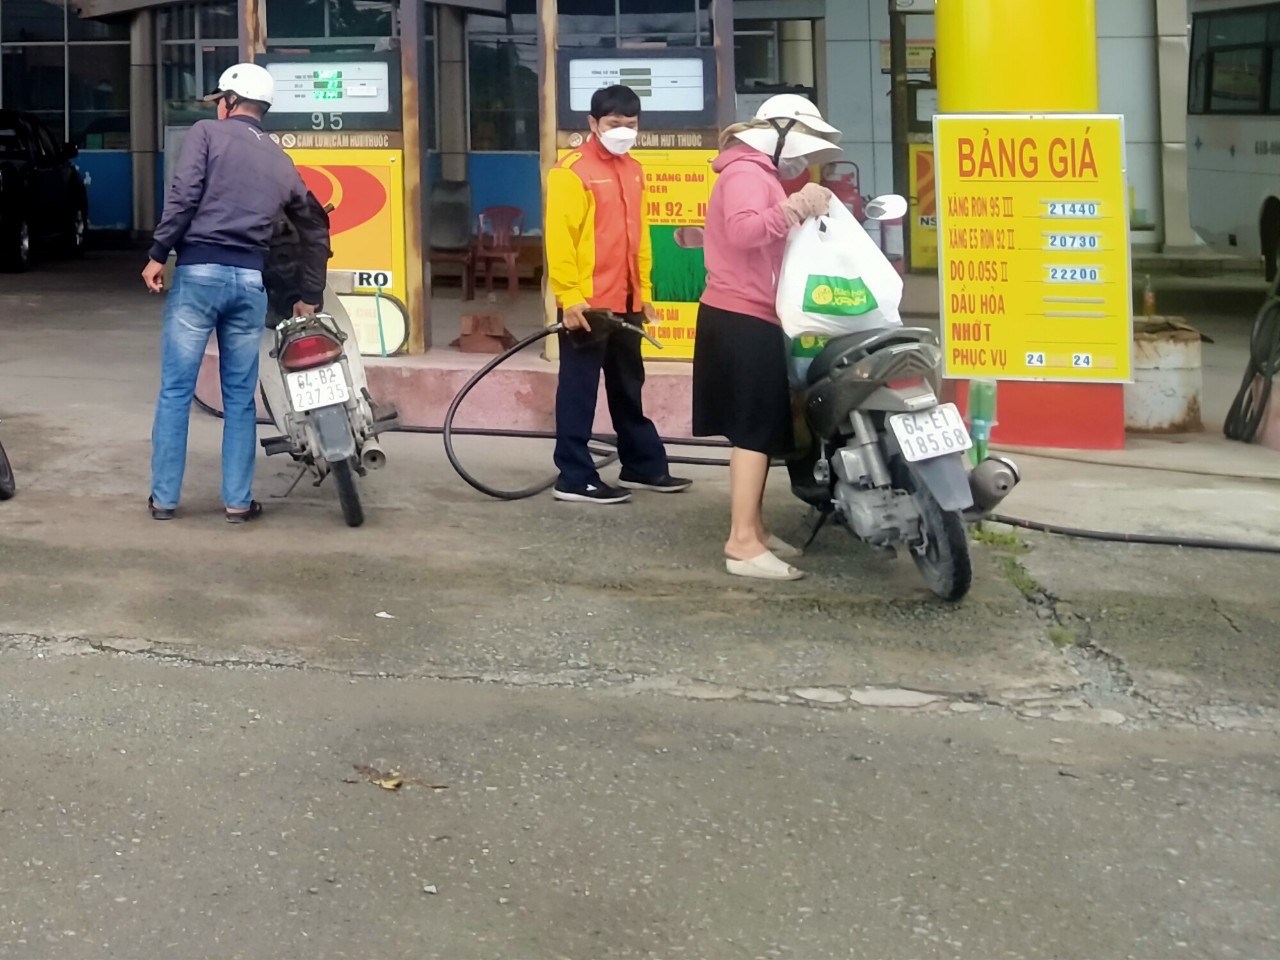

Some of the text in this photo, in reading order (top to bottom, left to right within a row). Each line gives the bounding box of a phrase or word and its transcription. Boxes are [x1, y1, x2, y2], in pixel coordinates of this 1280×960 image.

[957, 126, 1098, 178] BẢNG GIÁ
[665, 202, 683, 216] 92
[1049, 203, 1096, 216] 21440
[1049, 235, 1096, 248] 20730
[950, 260, 964, 281] DO
[968, 260, 998, 282] 0.05S
[1050, 268, 1097, 280] 22200
[951, 284, 1005, 315] DẦU HỎA
[953, 348, 1091, 370] PHỤC VỤ 24 24
